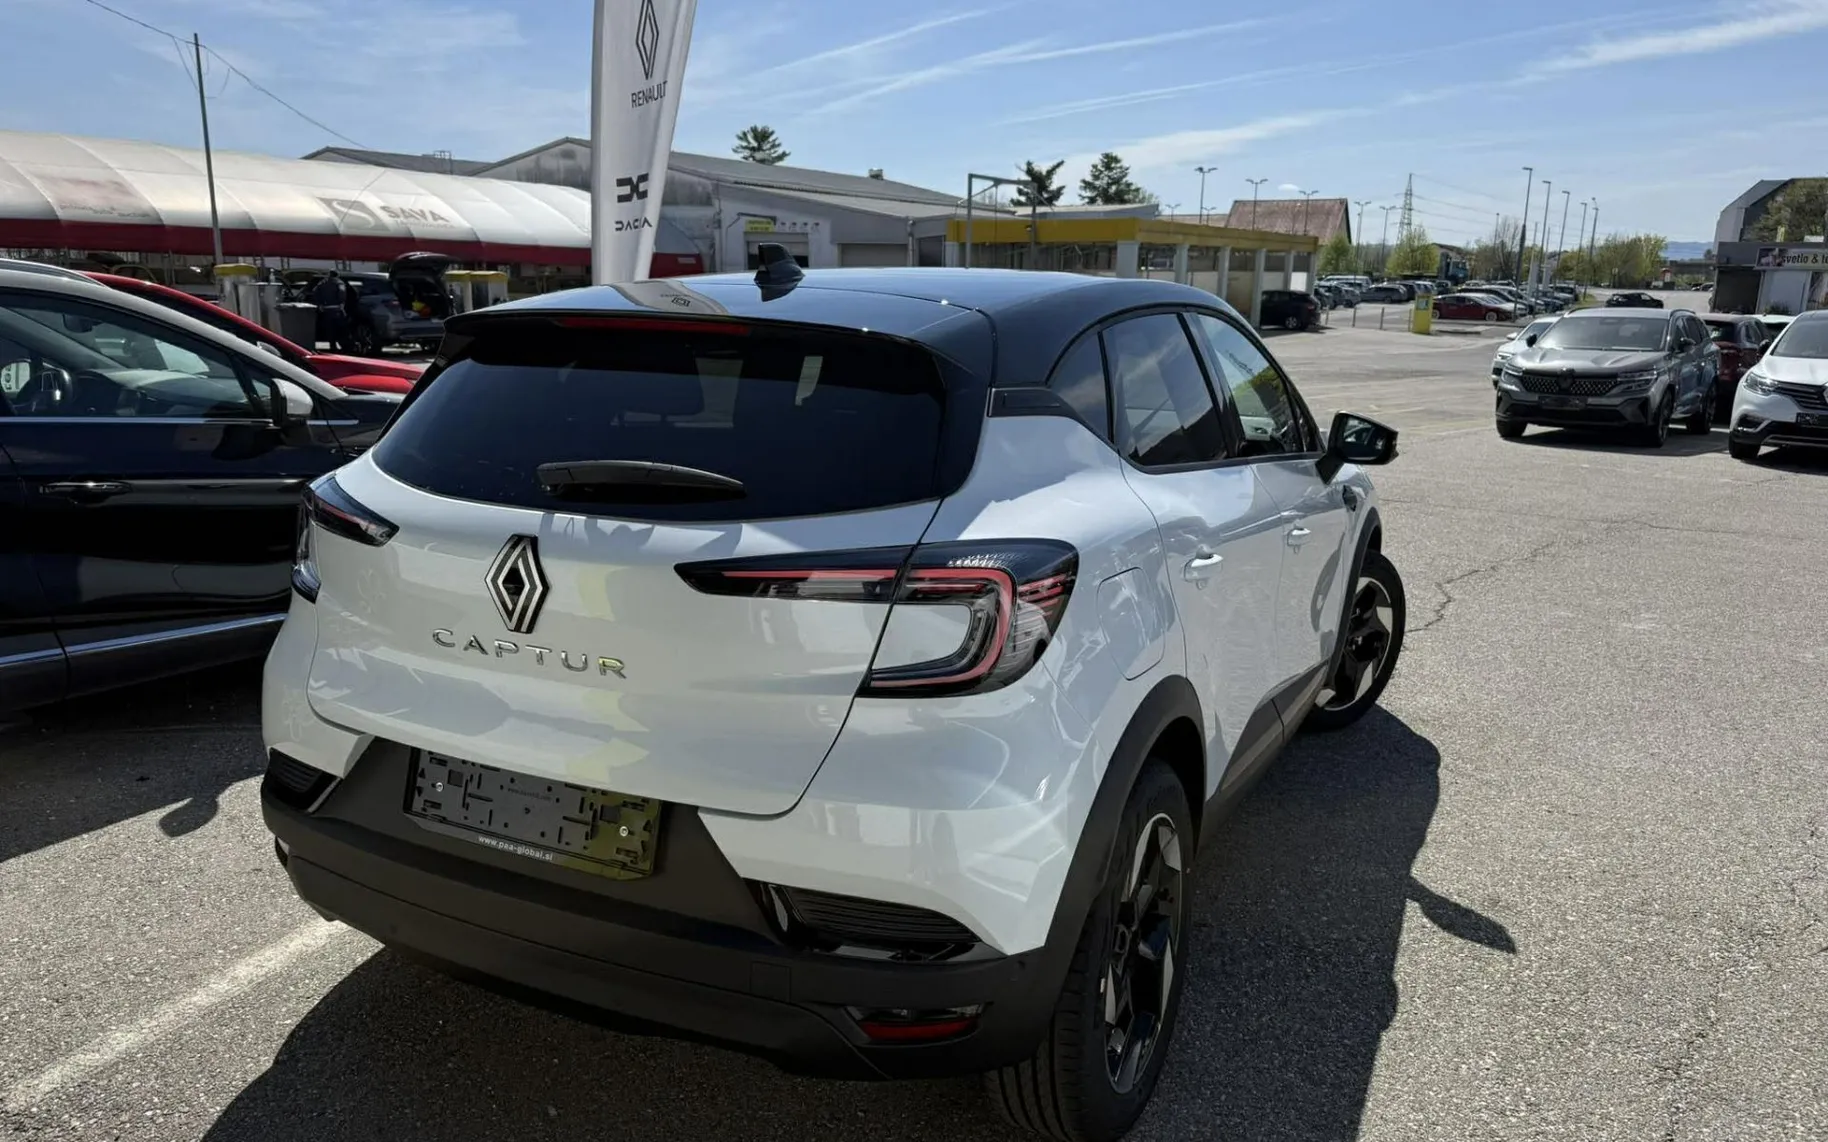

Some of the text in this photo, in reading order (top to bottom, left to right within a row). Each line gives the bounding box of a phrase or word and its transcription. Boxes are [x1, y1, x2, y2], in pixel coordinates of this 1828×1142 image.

[631, 80, 668, 108] RENAULT
[380, 205, 450, 223] SAVA
[614, 217, 653, 232] DACIA
[1811, 253, 1819, 265] &
[432, 628, 627, 679] CAPTUR
